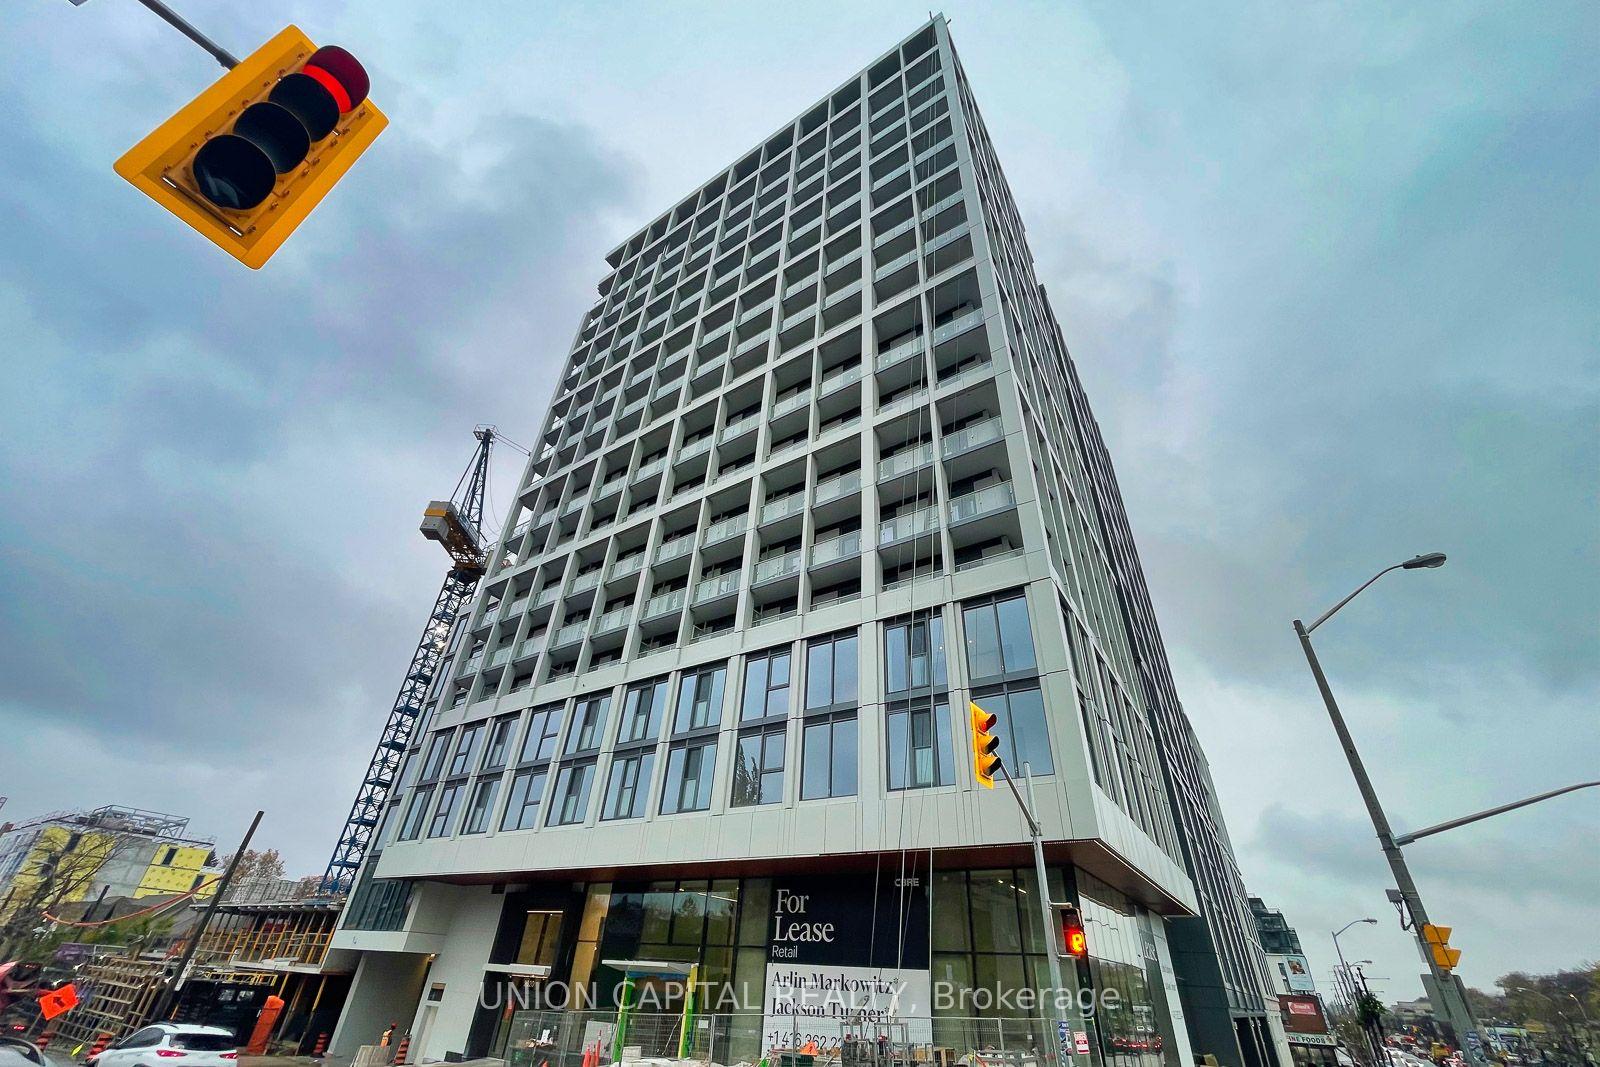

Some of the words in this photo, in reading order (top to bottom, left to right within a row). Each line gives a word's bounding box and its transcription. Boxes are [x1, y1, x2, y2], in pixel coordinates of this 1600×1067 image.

[895, 878, 920, 887] CBRE
[775, 889, 809, 914] For
[773, 916, 835, 942] Lease
[772, 945, 798, 958] Retail
[771, 971, 807, 988] Arlin
[770, 997, 825, 1017] Jackson
